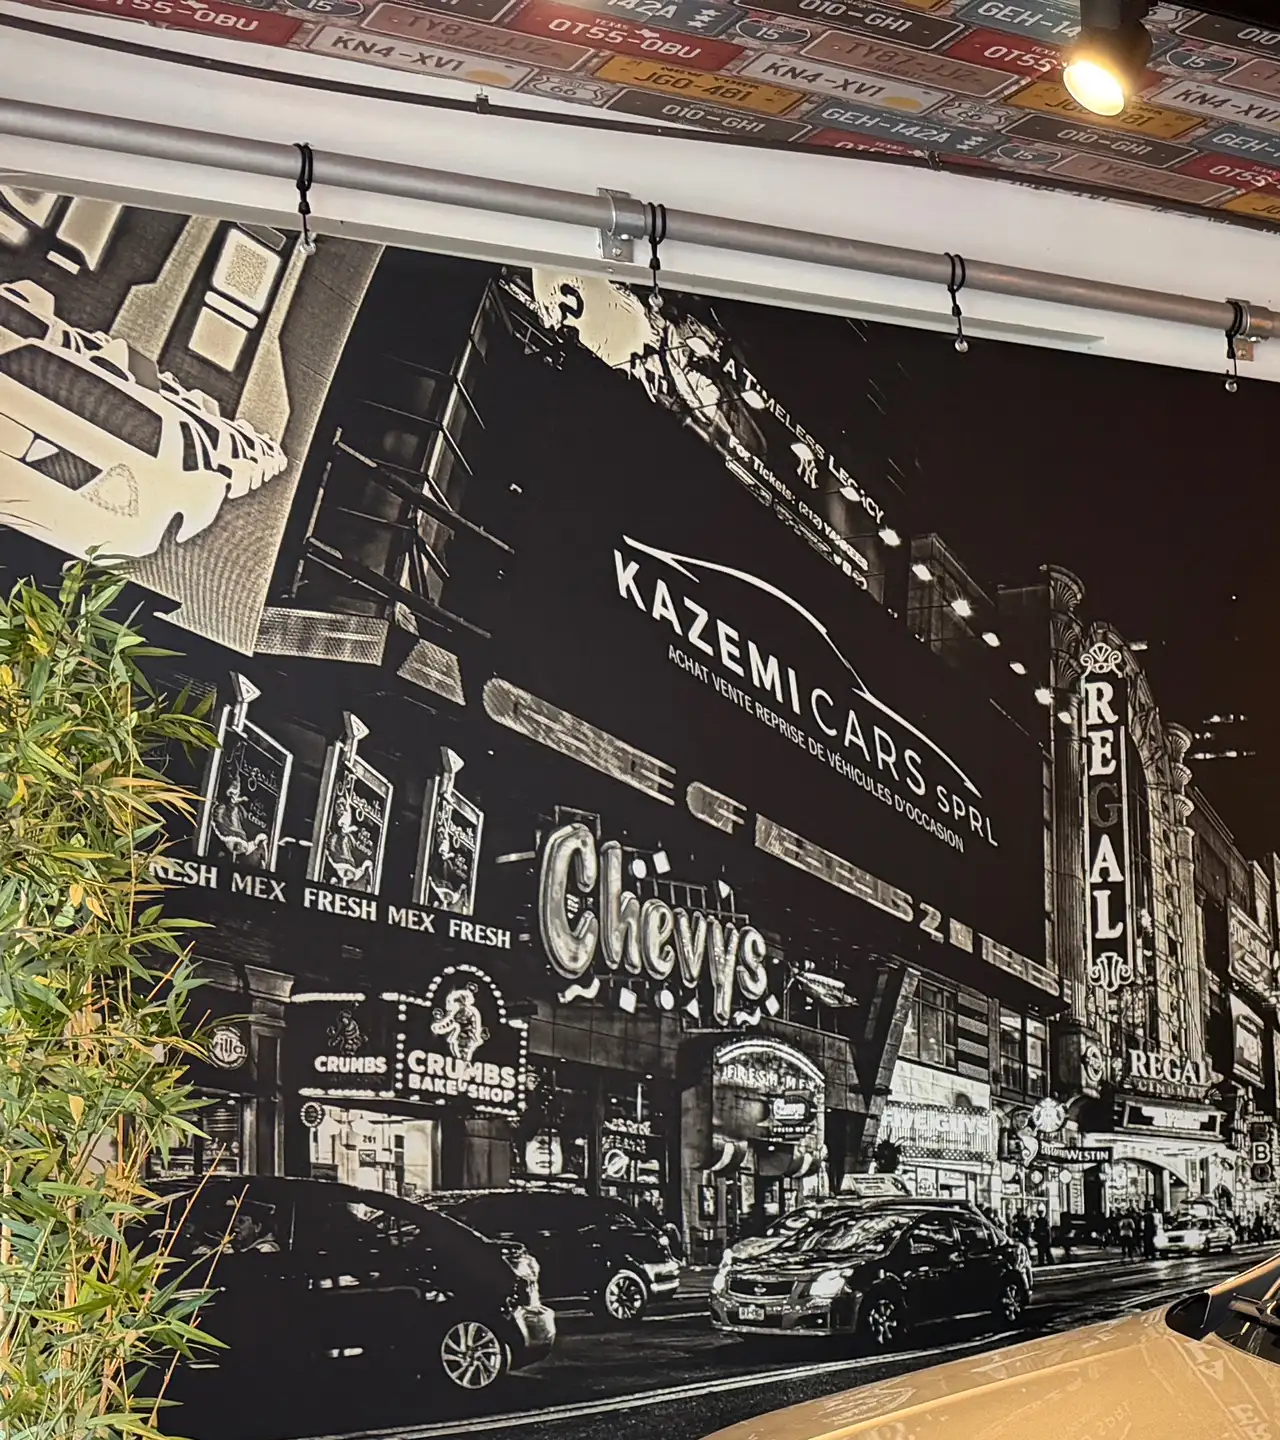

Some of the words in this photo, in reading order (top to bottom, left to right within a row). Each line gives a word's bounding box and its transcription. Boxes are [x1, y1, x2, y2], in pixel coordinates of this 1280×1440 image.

[756, 27, 780, 40] 15
[977, 2, 1082, 38] GEH-14
[613, 548, 800, 715] KAZEMI
[810, 687, 927, 796] CARS
[935, 784, 999, 848] SPRL
[667, 643, 710, 684] ACHAT
[711, 676, 754, 715] VENTE
[755, 702, 807, 750] REPRISE
[808, 735, 827, 760] DE
[825, 749, 894, 808] VÉHICULES
[894, 798, 965, 854] D'OCCASION
[1084, 681, 1125, 941] REGAL
[149, 858, 218, 889] RESH
[231, 872, 287, 903] MEX
[303, 887, 378, 922] FRESH
[387, 904, 436, 934] MEX
[449, 918, 513, 950] FRESH
[539, 822, 767, 1027] Chevys
[314, 1055, 388, 1075] CRUMBS
[407, 1049, 517, 1089] CRUMBS
[1128, 1049, 1212, 1087] REGAL
[408, 1073, 458, 1096] BAKE
[467, 1083, 516, 1104] SHOP
[1066, 1149, 1109, 1162] WESTIN
